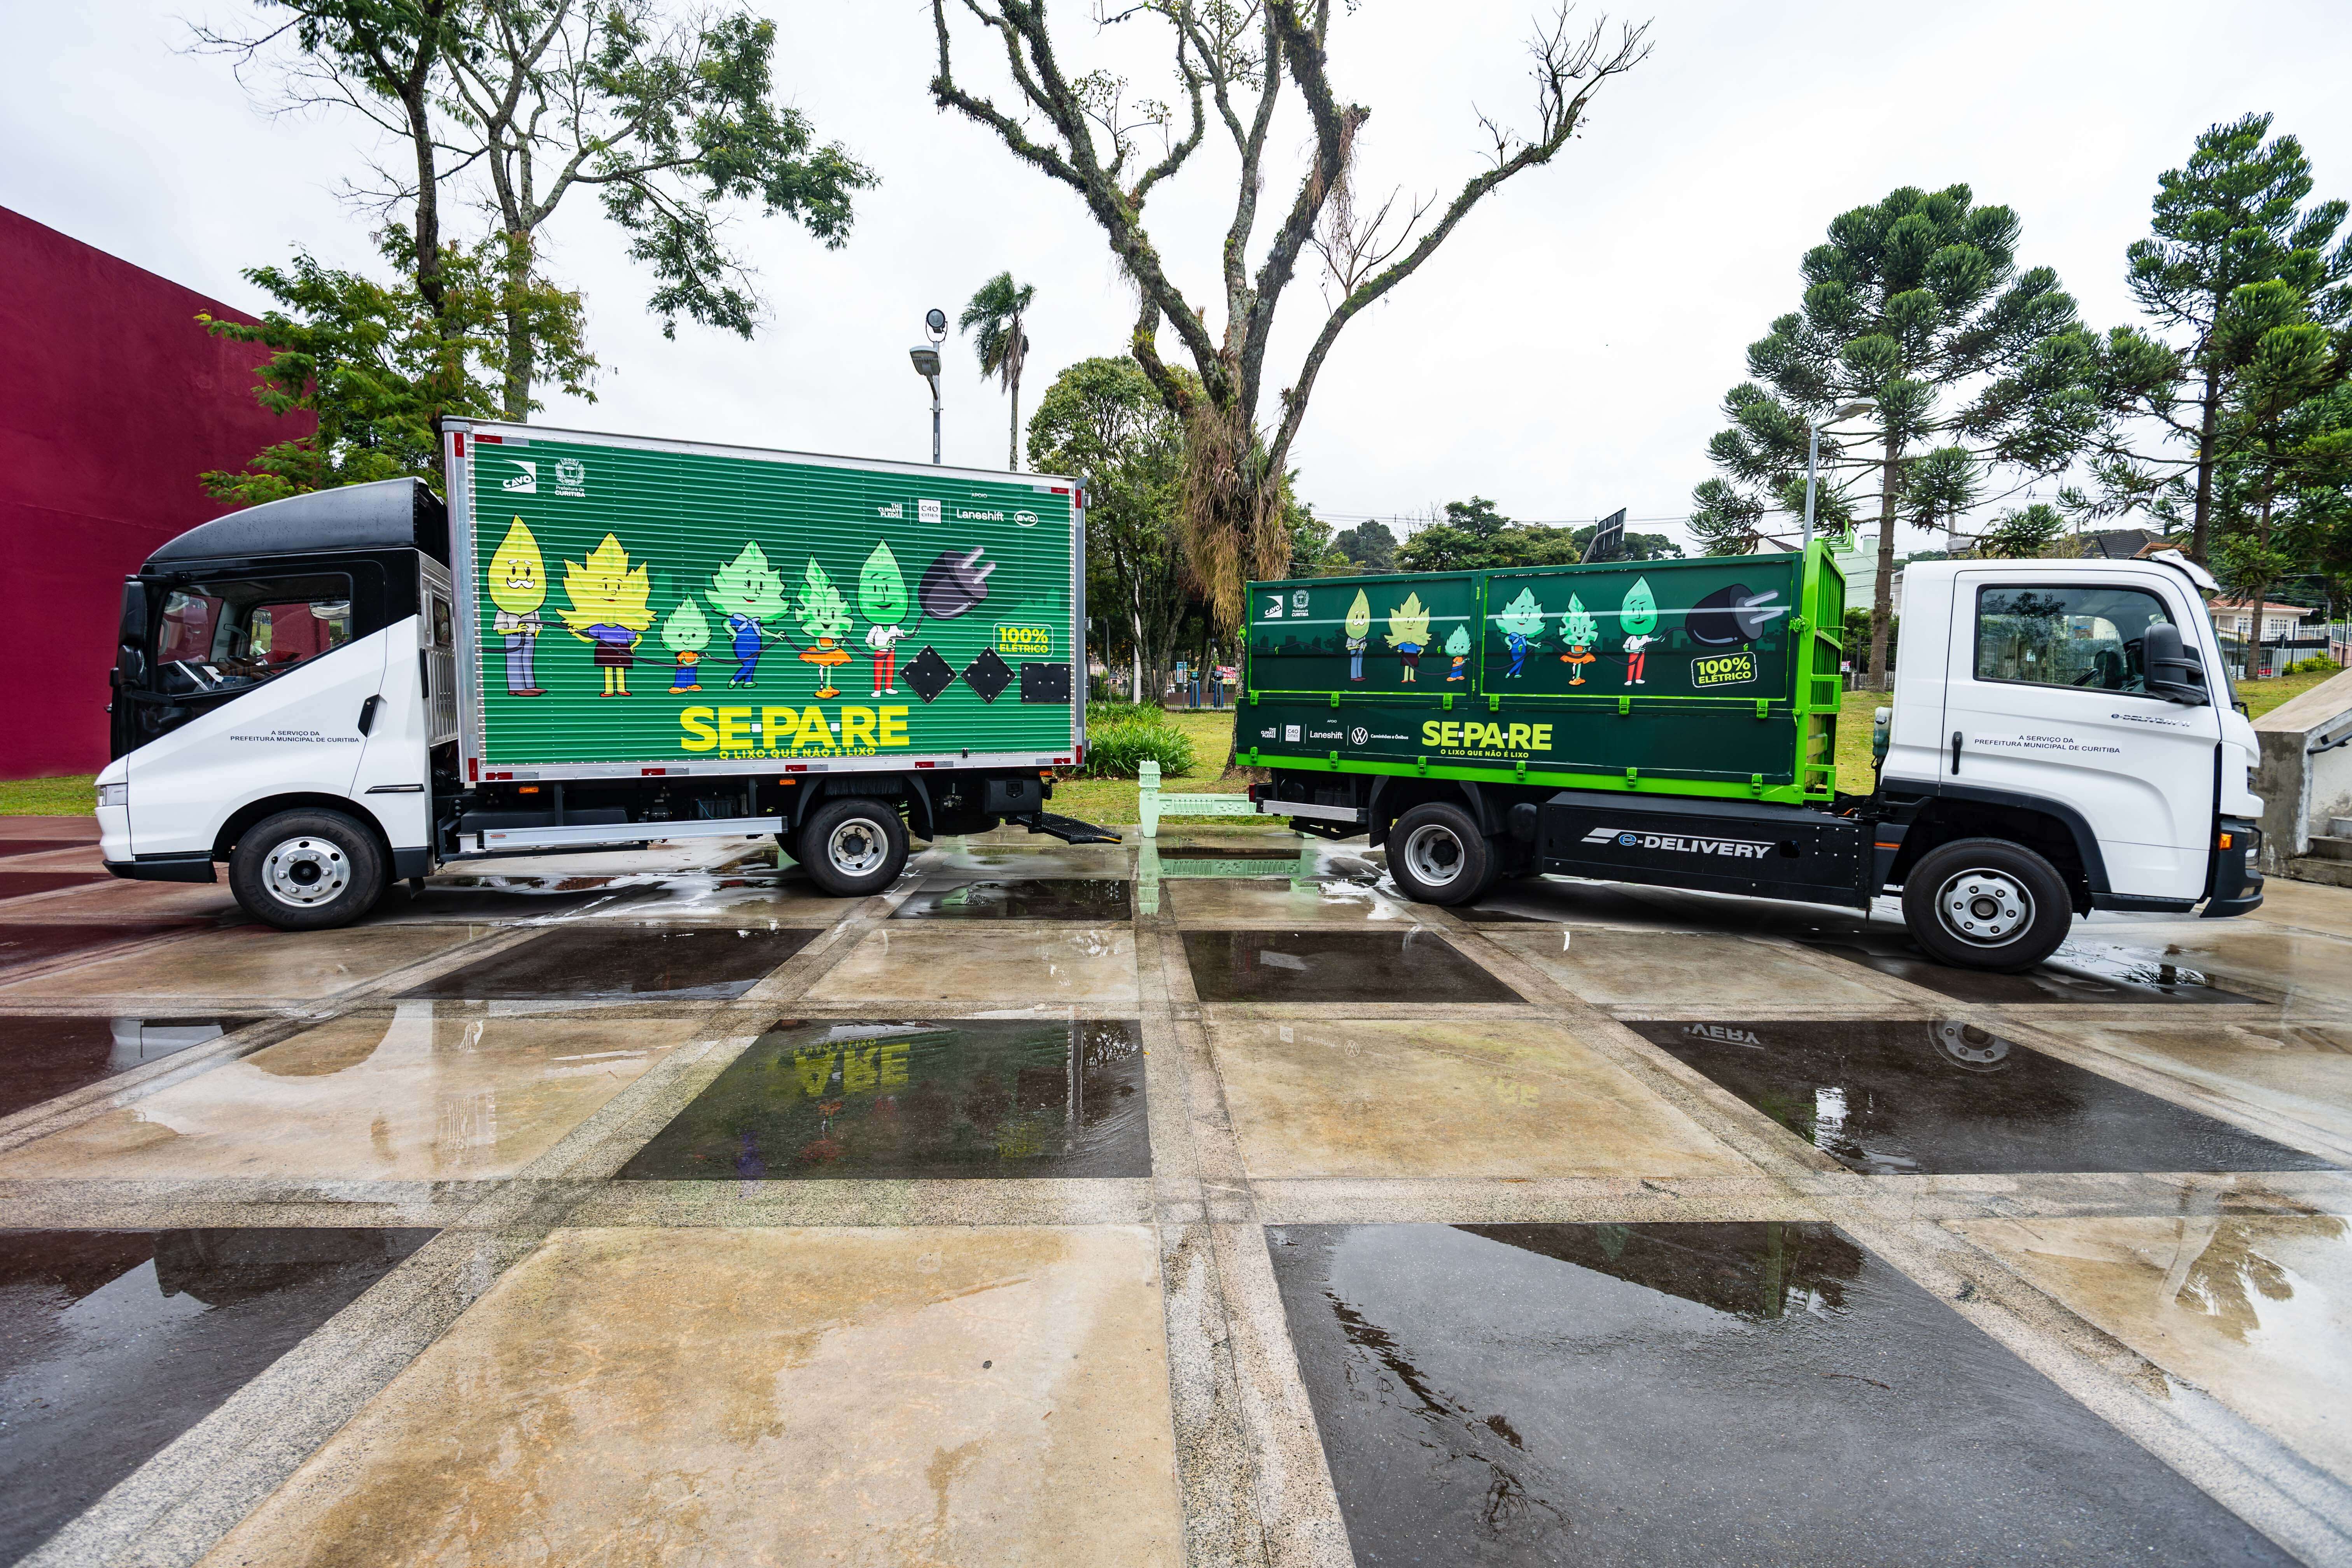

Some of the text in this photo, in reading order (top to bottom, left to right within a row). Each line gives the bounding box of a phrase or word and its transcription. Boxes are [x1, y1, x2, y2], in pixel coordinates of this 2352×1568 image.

[503, 475, 532, 488] CAVO
[956, 508, 1004, 522] Laneshift
[1265, 605, 1280, 616] CAVO
[999, 627, 1048, 644] 100%
[999, 643, 1048, 653] ELÉTRICO
[1697, 656, 1751, 675] 100%
[1698, 671, 1752, 684] ELÉTRICO
[1309, 730, 1343, 739] Laneshift
[719, 746, 876, 760] O LIXO QUE NÃO É LIXO
[1619, 833, 1771, 859] e-DELIVERY
